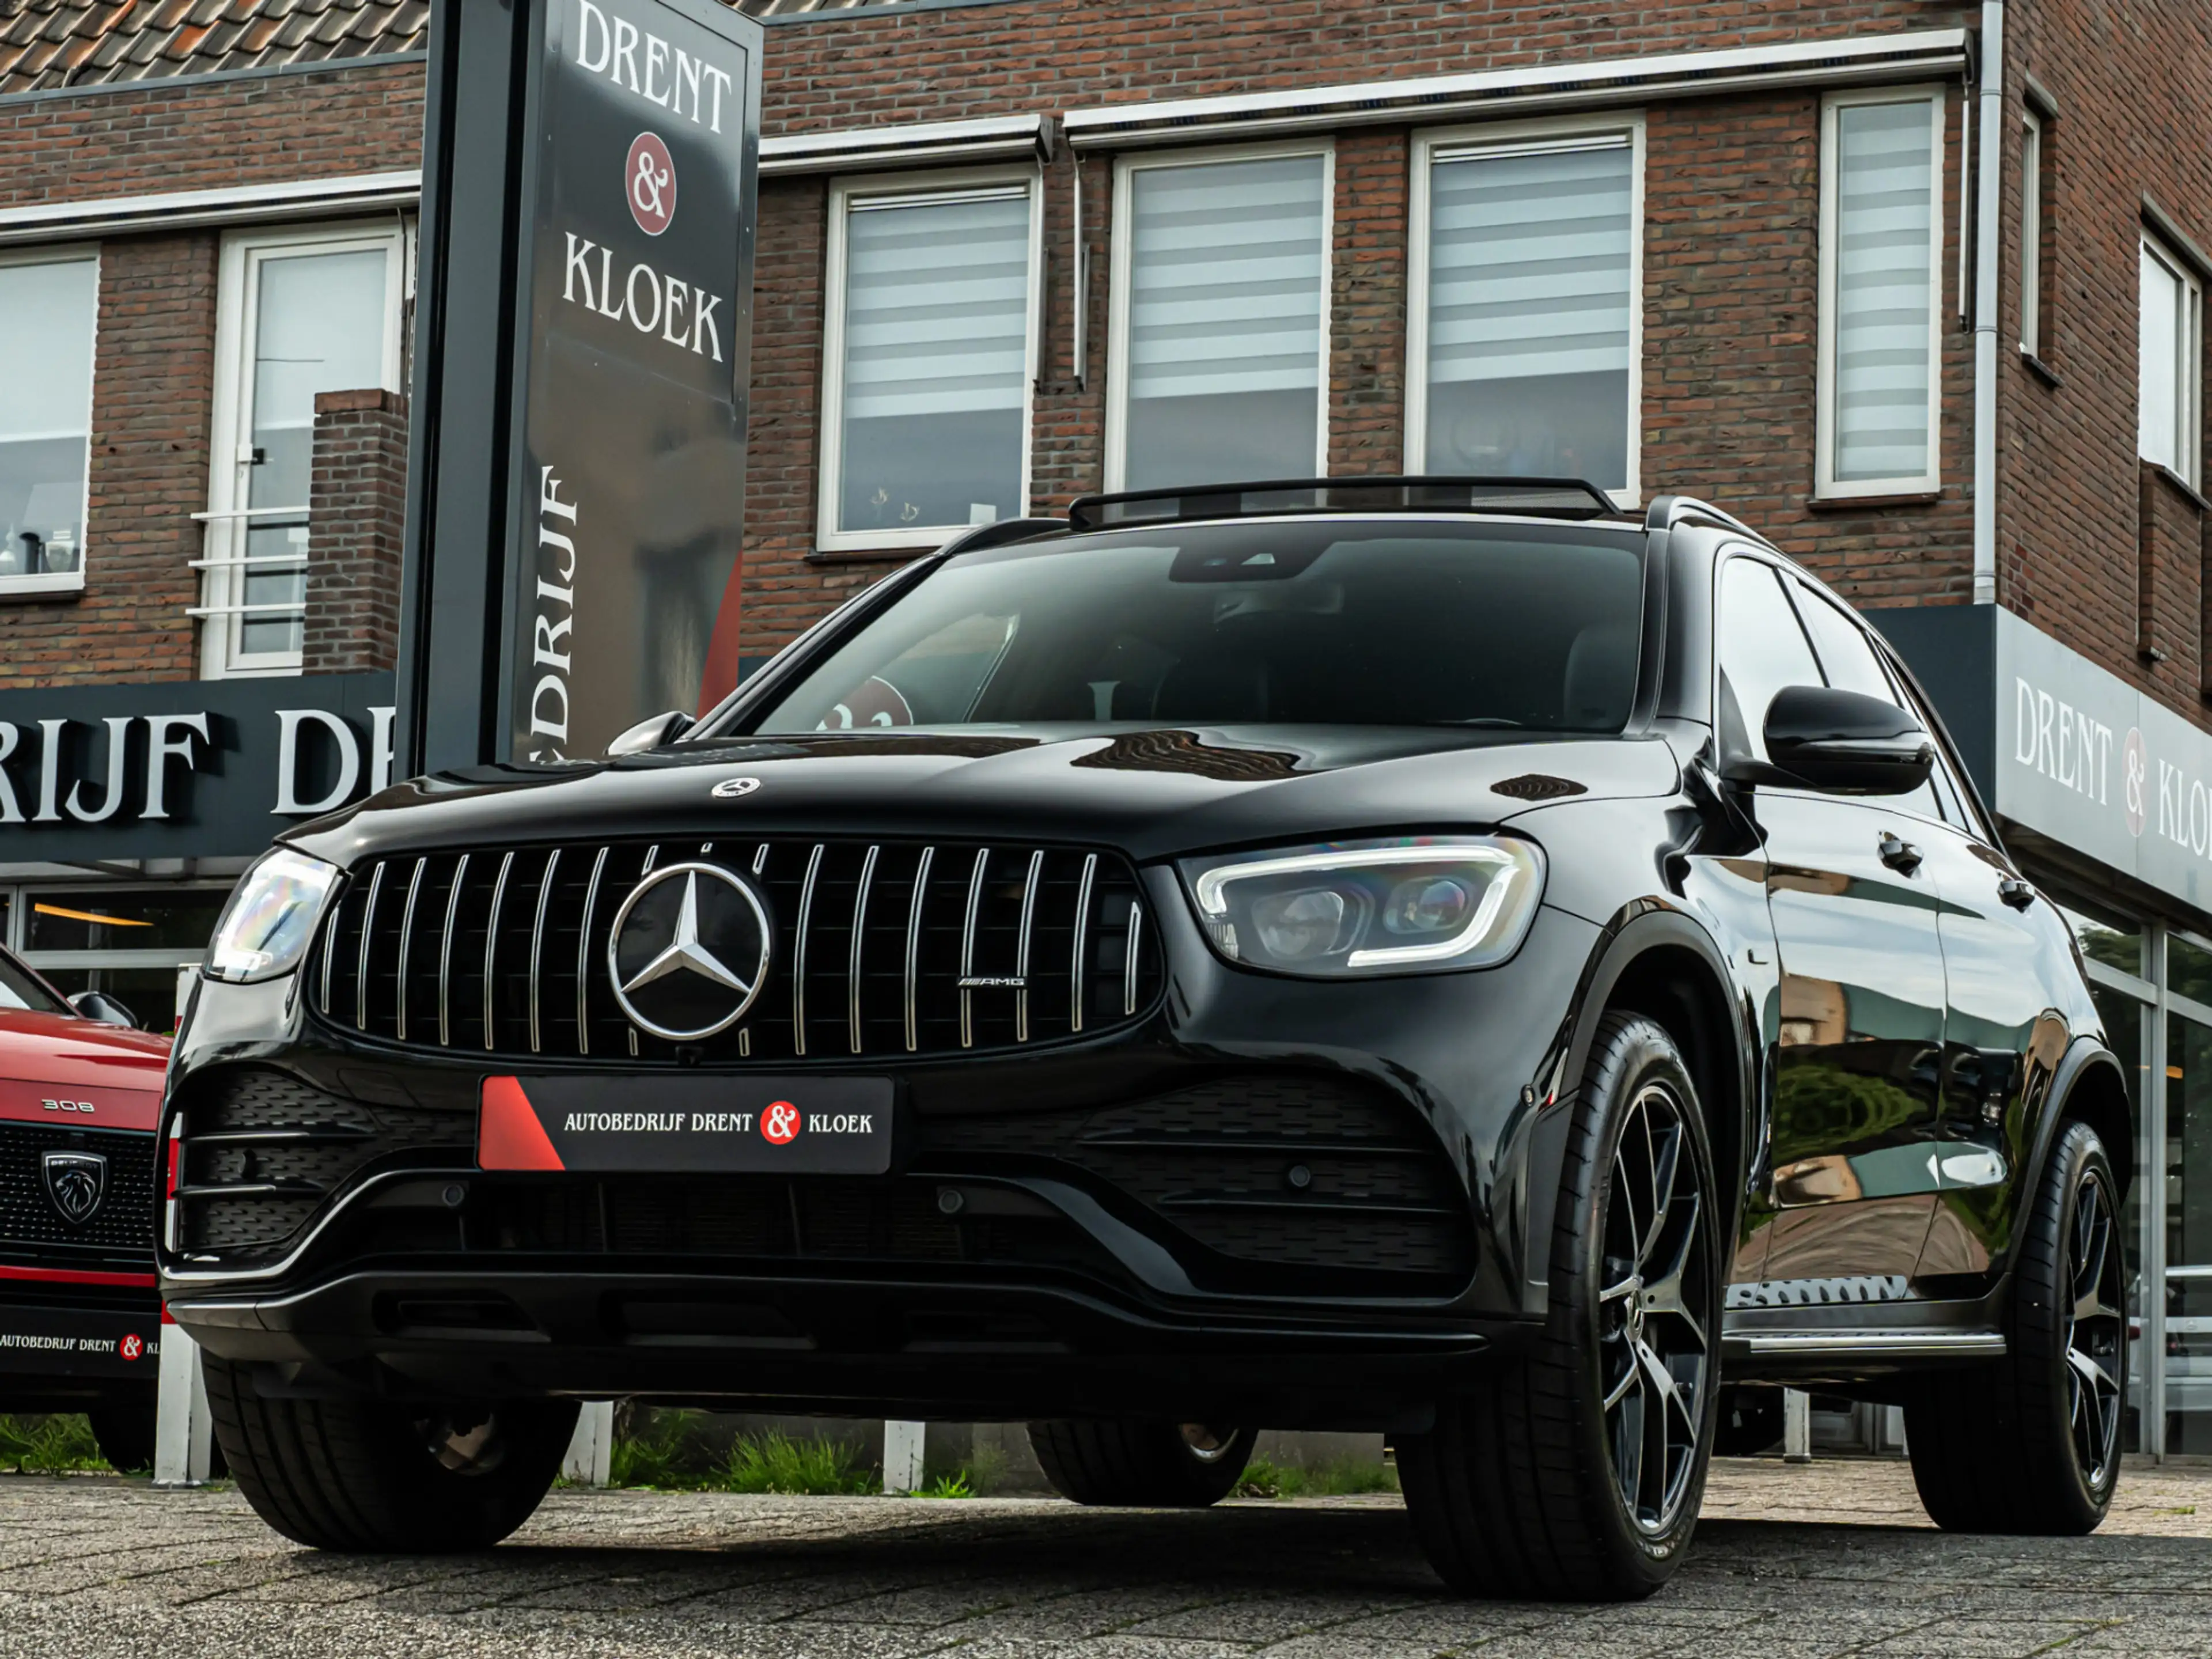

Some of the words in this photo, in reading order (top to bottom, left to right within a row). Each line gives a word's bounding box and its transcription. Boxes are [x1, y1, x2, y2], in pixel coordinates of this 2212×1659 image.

[576, 0, 732, 134] DRENT
[633, 151, 668, 218] &
[562, 232, 723, 362] KLOEK
[2016, 676, 2112, 806] DRENT
[2127, 749, 2144, 816] &
[2158, 758, 2212, 861] KLO
[41, 1099, 95, 1112] 308
[565, 1113, 685, 1131] AUTOBEDRIJF
[691, 1113, 752, 1131] DRENT
[767, 1105, 796, 1138] &
[809, 1115, 872, 1132] KLOEK
[0, 1334, 76, 1350] AUTOBEDRIJF
[79, 1338, 115, 1352] DRENT
[124, 1336, 140, 1357] &
